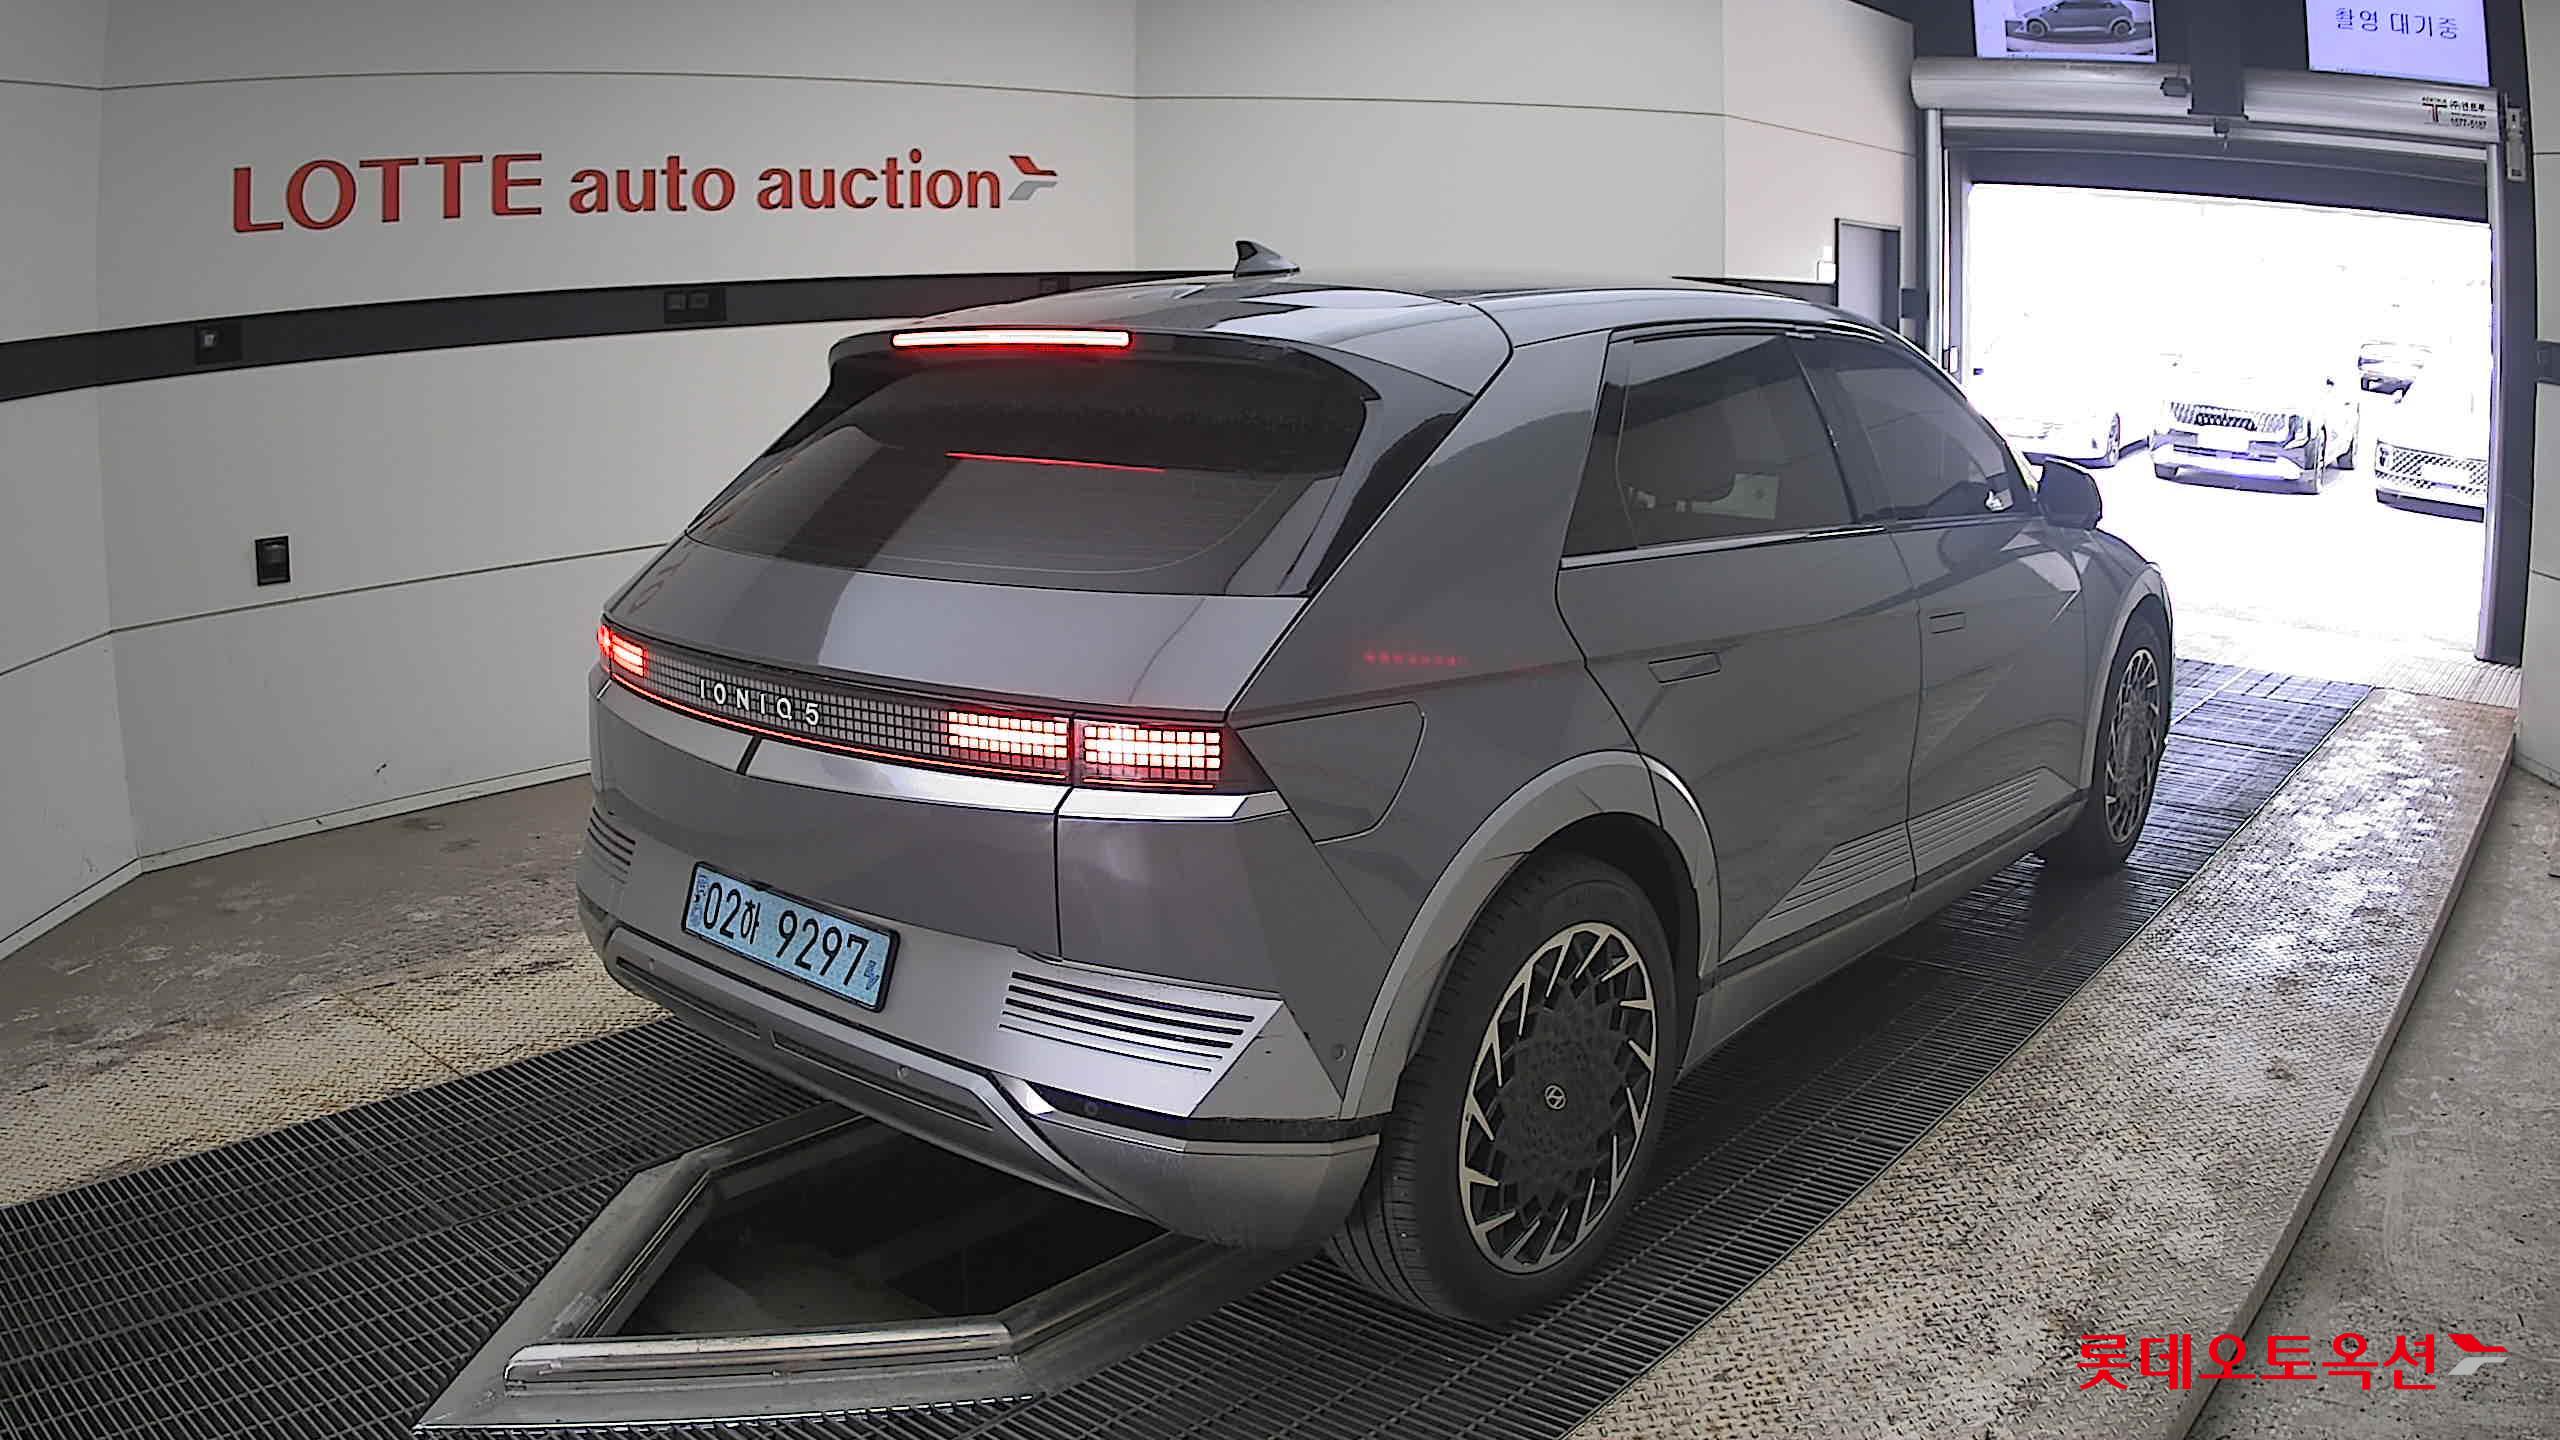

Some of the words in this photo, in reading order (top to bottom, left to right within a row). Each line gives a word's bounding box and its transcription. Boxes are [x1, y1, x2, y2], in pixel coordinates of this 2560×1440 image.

[2336, 8, 2378, 32] 촬영
[233, 152, 543, 233] LOTTE
[569, 156, 735, 213] auto
[757, 148, 1002, 210] auction
[700, 679, 792, 721] IONIQ
[805, 702, 820, 726] 5
[703, 881, 761, 945] 02하
[775, 910, 869, 987] 9297
